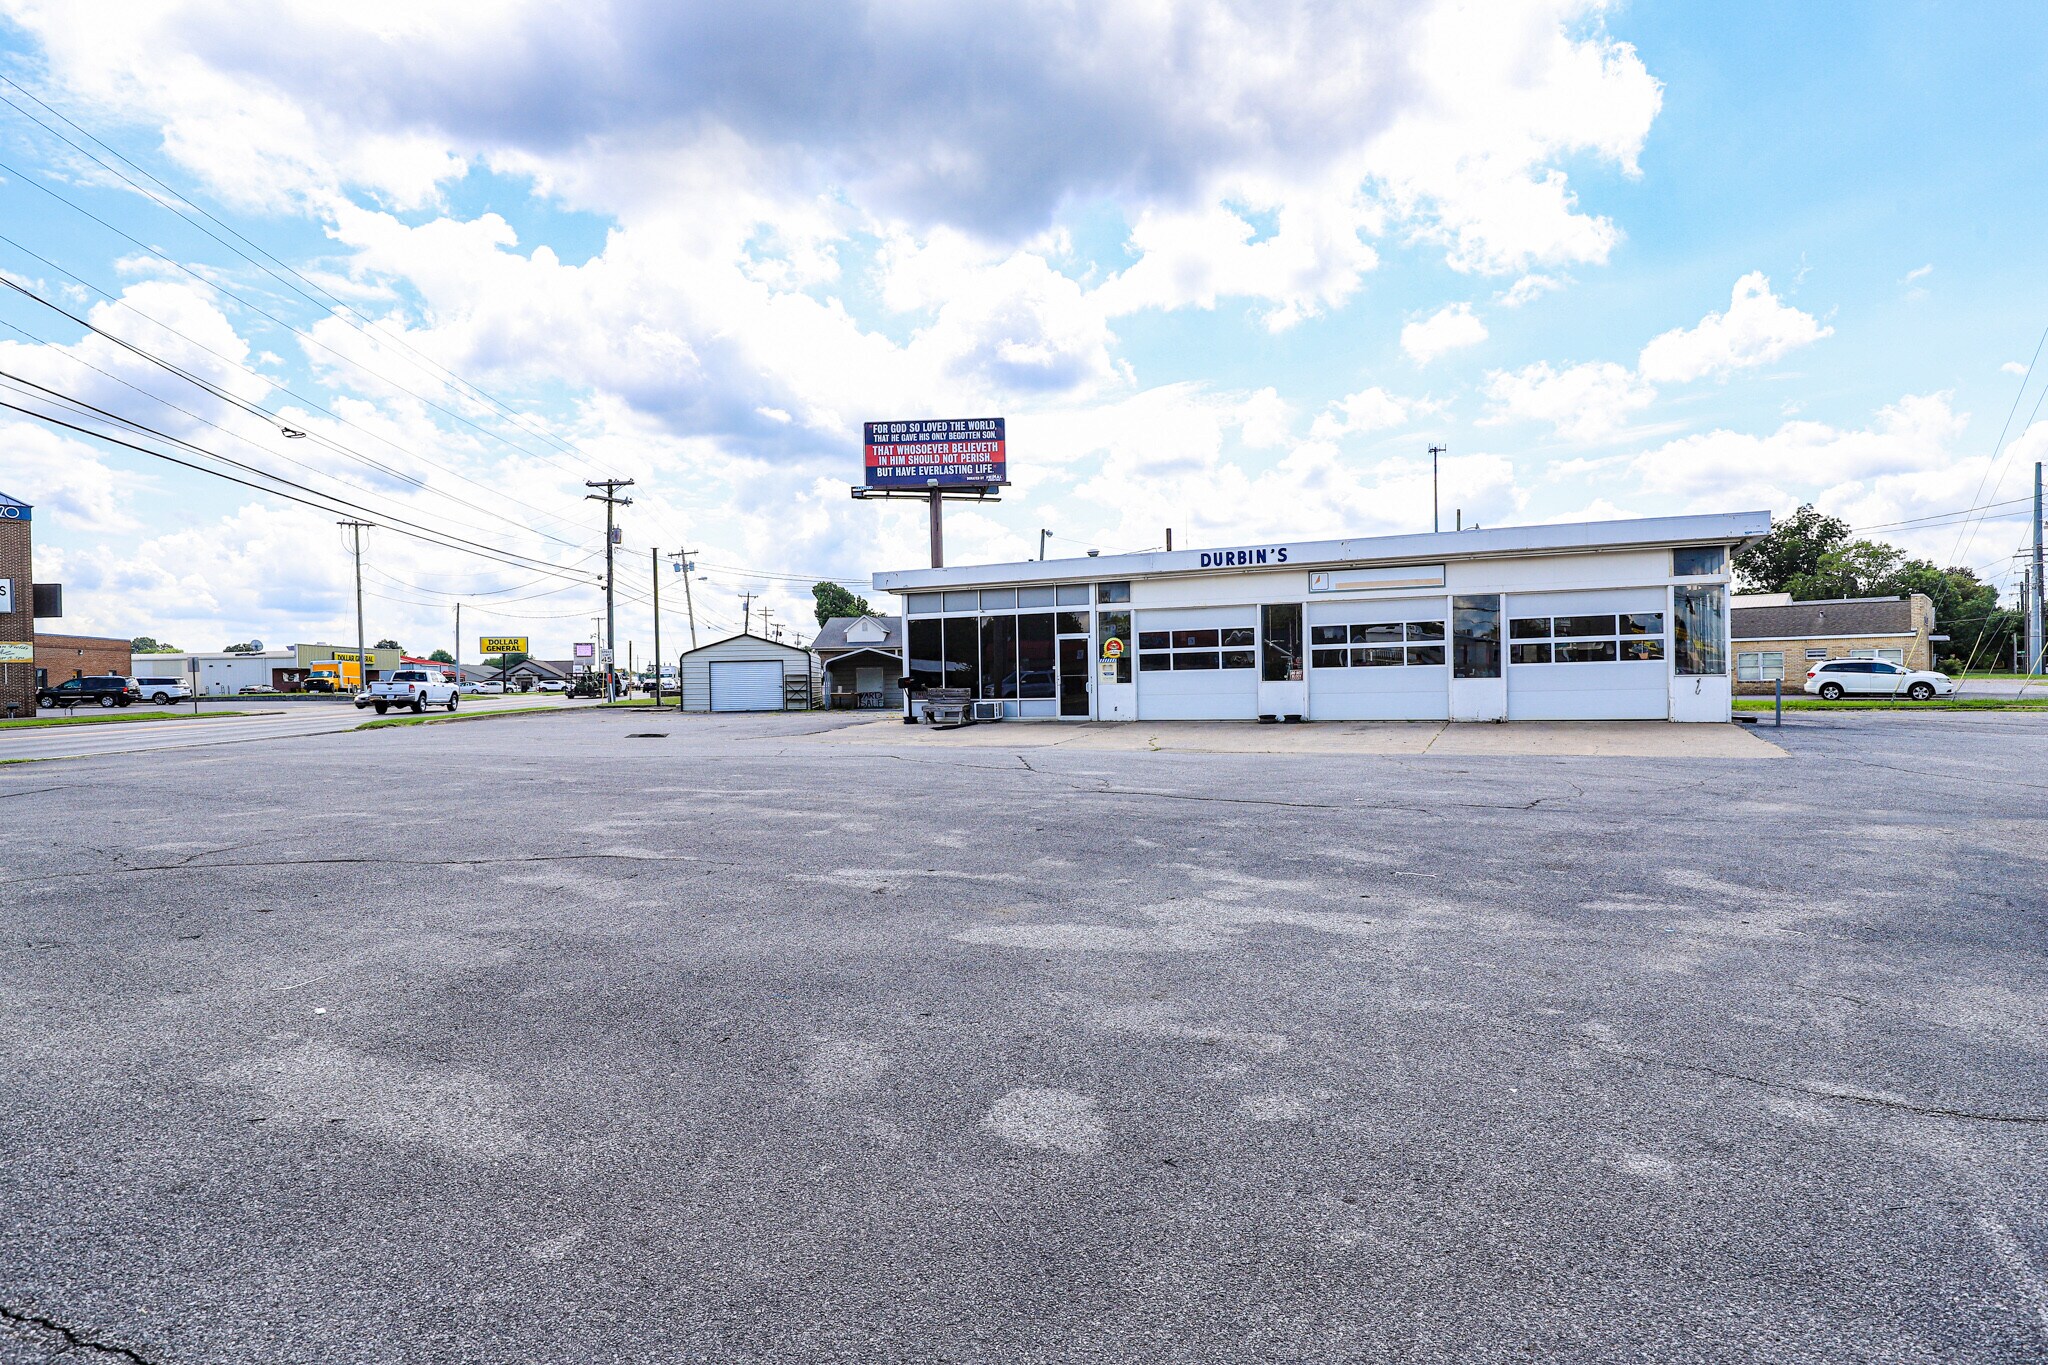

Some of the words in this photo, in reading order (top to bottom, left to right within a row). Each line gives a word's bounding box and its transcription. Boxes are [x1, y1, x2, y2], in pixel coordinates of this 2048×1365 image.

[890, 423, 907, 433] GOD
[909, 423, 920, 433] SO
[923, 422, 947, 432] LOVED
[950, 421, 965, 431] THE
[873, 434, 890, 442] THAT
[891, 434, 900, 442] HE
[901, 433, 917, 442] GAVE
[919, 433, 930, 441] HIS
[931, 432, 947, 441] ONLY
[948, 431, 981, 440] BEGOTTEN
[872, 445, 894, 456] THAT
[896, 443, 949, 455] WHOSOEVER
[951, 442, 998, 453] BELIEVETH
[878, 456, 887, 465] IN
[890, 455, 905, 465] HIM
[908, 454, 940, 465] SHOULD
[942, 454, 958, 463] NOT
[877, 467, 893, 477] BUT
[895, 466, 916, 477] HAVE
[918, 464, 973, 476] EVERLASTING
[1200, 547, 1288, 567] DURBIN'S
[337, 654, 355, 662] DOLLAR
[859, 699, 884, 708] SALE
